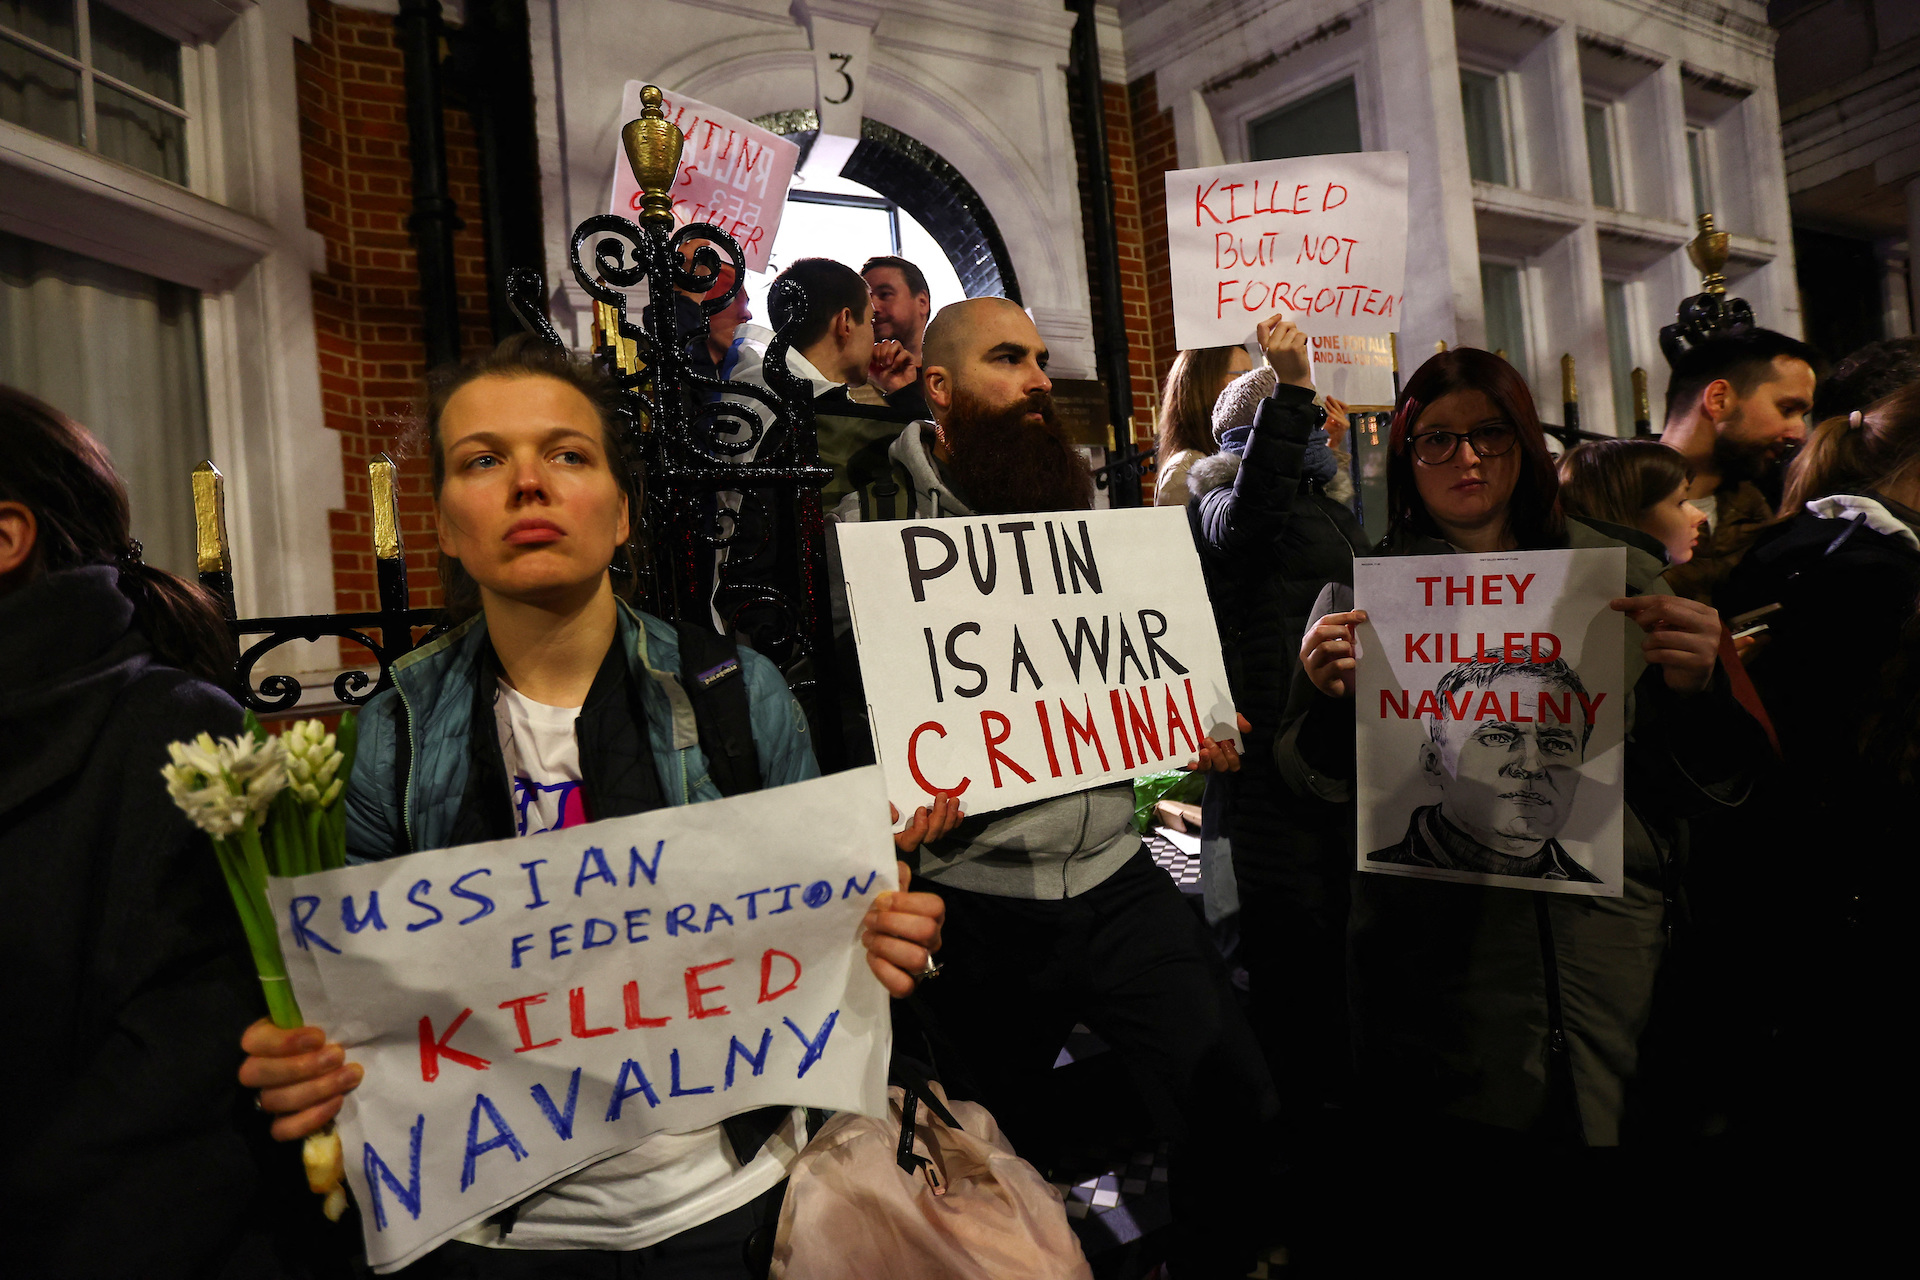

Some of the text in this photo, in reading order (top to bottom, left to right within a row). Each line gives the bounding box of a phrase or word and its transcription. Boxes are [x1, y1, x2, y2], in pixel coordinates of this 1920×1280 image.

[825, 53, 855, 104] 3
[1196, 178, 1349, 227] KILLED
[1215, 232, 1360, 274] BUT NOT
[1312, 335, 1389, 353] ONE FOR ALL
[1313, 351, 1335, 363] AND
[1336, 352, 1353, 364] ALL
[900, 520, 1103, 602] PUTIN
[1416, 573, 1536, 607] THEY
[923, 609, 1190, 703] IS A WAR
[1404, 632, 1562, 664] KILLED
[704, 664, 738, 685] patagonia
[1380, 689, 1607, 724] NAVALNY
[907, 678, 1235, 799] CRIMINAL
[289, 840, 665, 954] RUSSIAN
[511, 871, 876, 968] FEDERATION
[418, 948, 802, 1083] KILLED
[363, 1009, 840, 1232] NAVALNY
